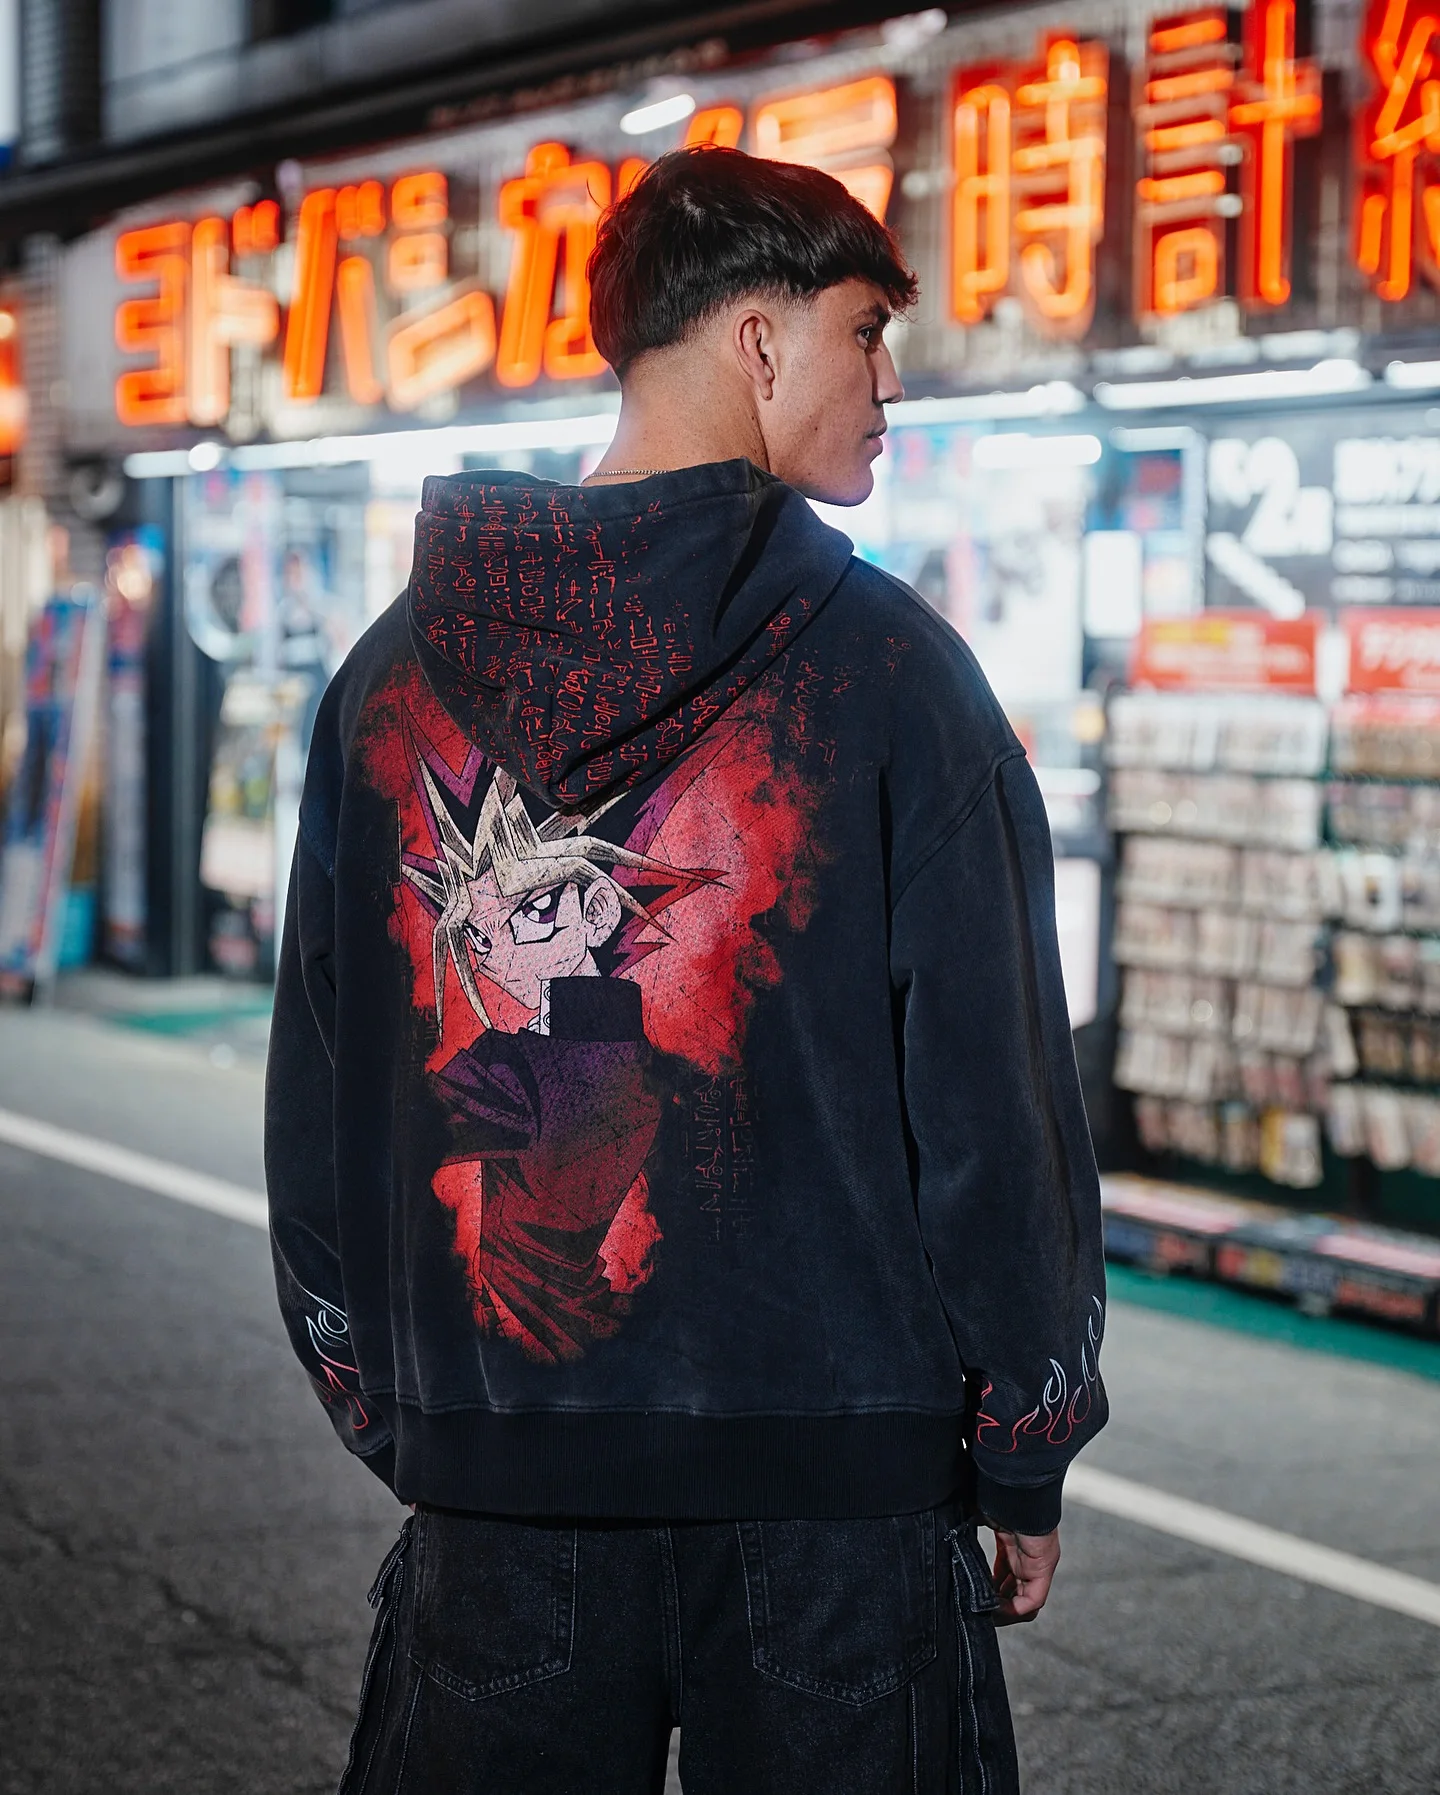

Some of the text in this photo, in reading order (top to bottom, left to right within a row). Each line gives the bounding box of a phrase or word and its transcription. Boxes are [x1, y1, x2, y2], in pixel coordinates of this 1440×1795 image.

[115, 75, 898, 427] ヨドバシカ
